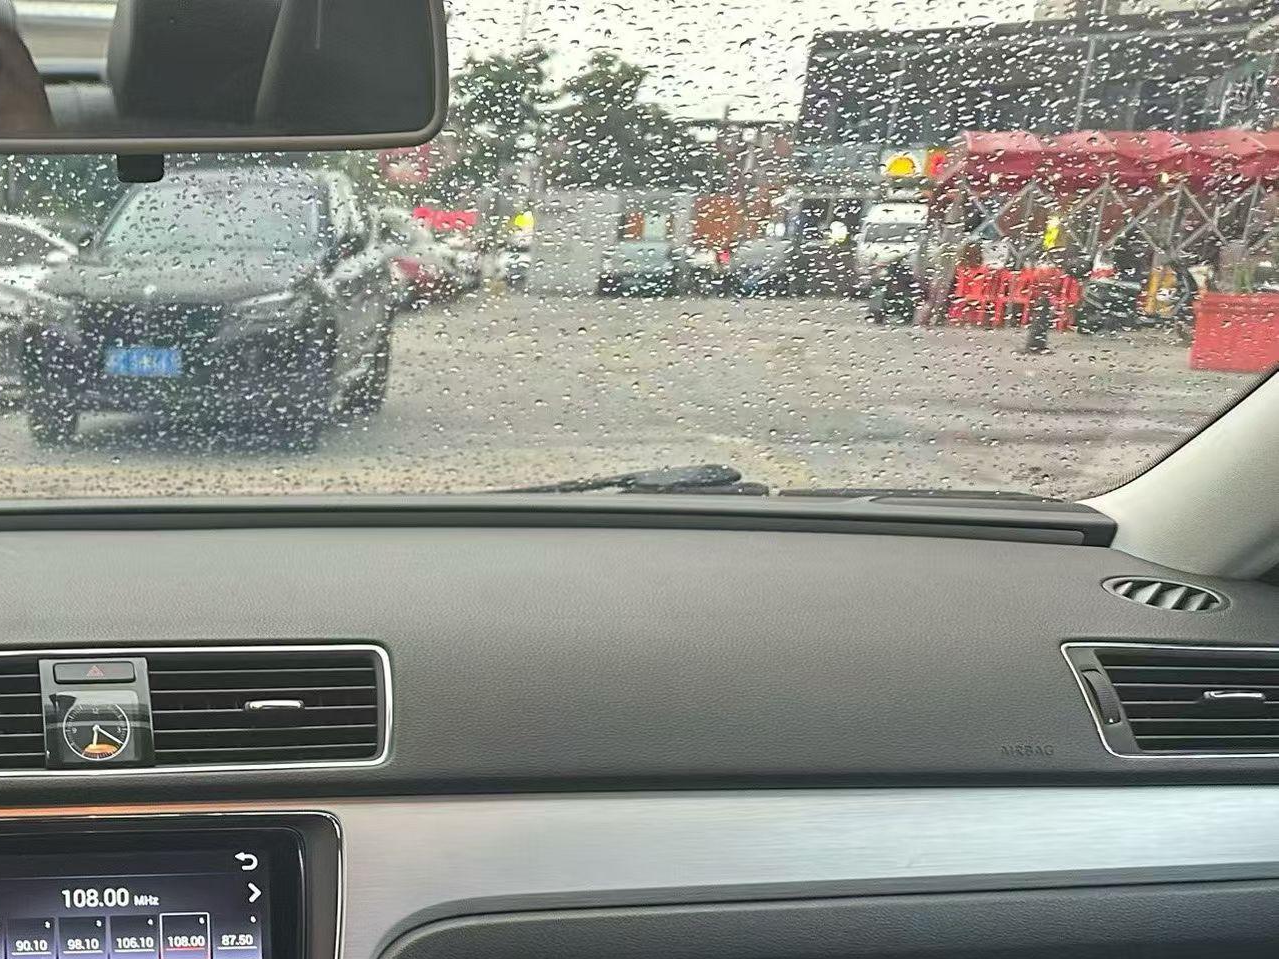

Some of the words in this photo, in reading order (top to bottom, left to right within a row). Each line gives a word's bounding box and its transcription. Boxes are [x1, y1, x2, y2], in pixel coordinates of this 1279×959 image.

[61, 888, 130, 908] 108.00
[133, 895, 159, 906] MHz
[15, 939, 48, 952] 90.10
[67, 937, 100, 951] 98.10
[116, 936, 154, 949] 106.10
[167, 935, 206, 947] 108.00
[221, 934, 254, 946] 87.50
